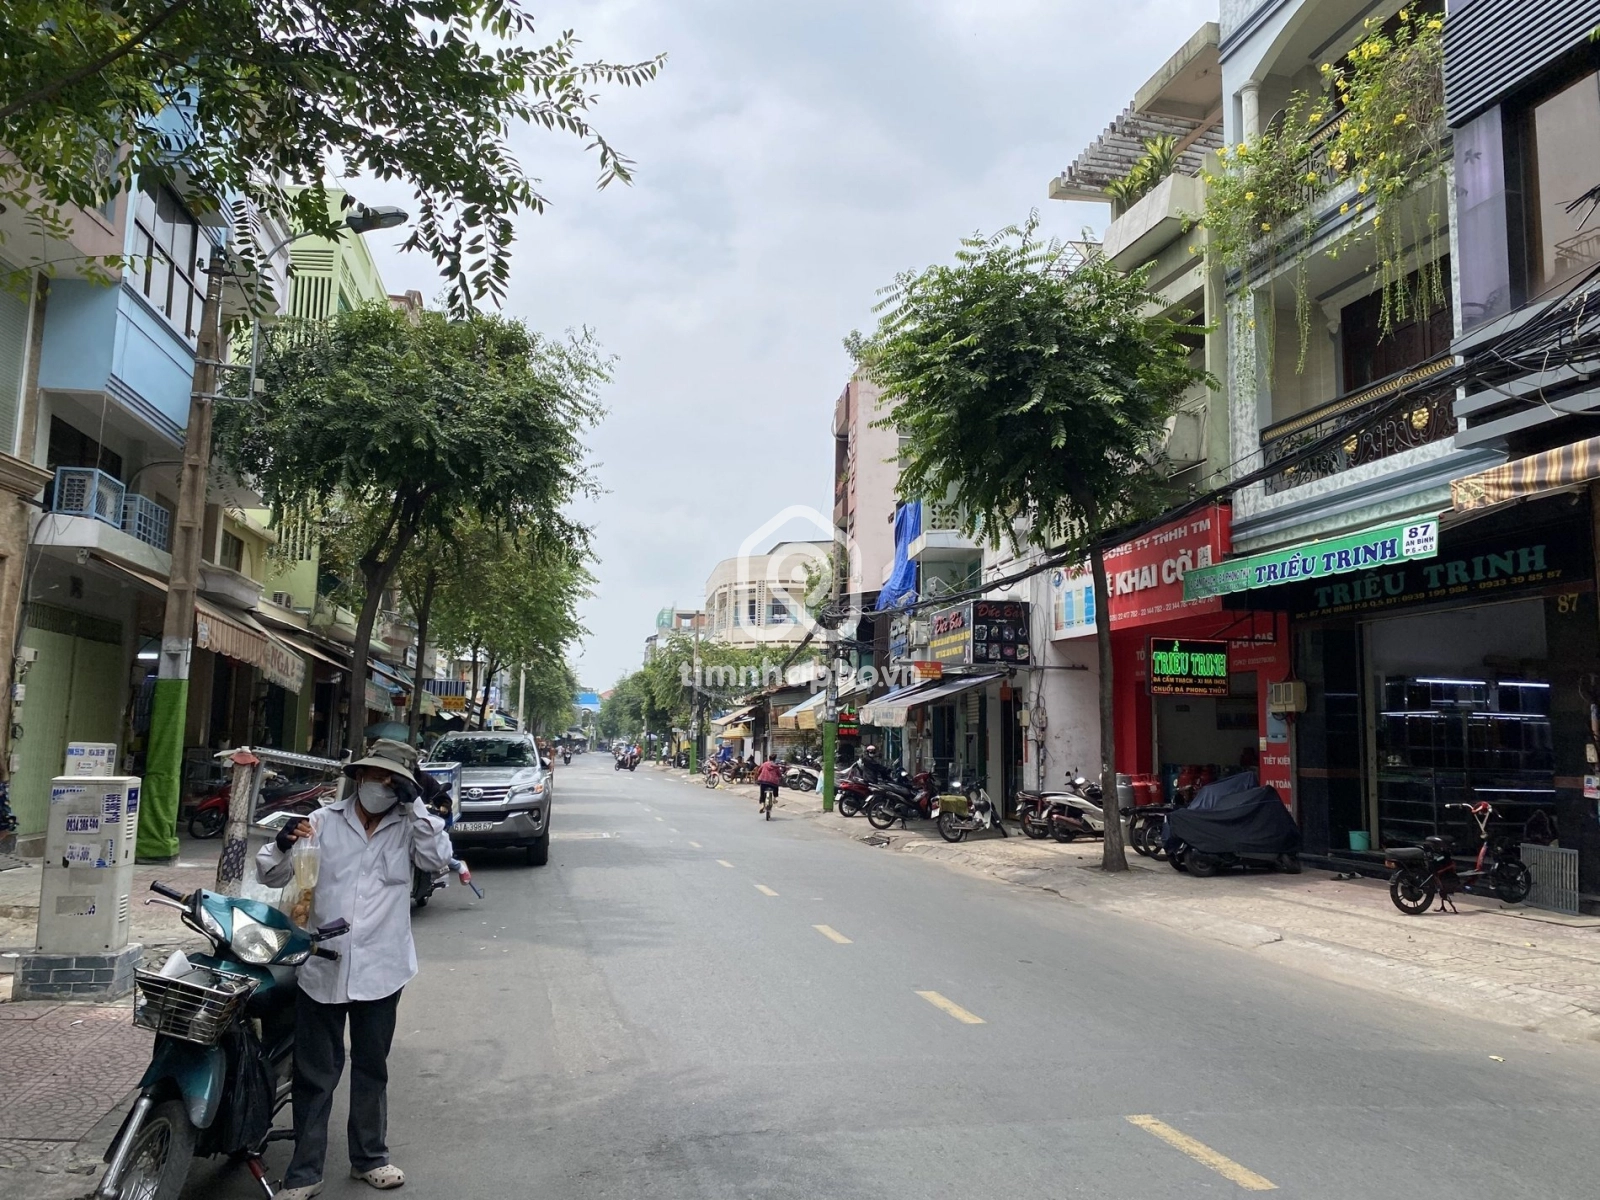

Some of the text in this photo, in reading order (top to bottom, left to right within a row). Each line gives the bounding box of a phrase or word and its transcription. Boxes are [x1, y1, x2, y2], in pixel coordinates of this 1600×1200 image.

[1135, 537, 1150, 550] TY
[1152, 525, 1188, 545] TNHH
[1191, 518, 1211, 534] TM
[1408, 524, 1430, 538] 87
[1417, 536, 1434, 545] BÌNH
[1255, 538, 1398, 583] TRIỀU TRINH
[1314, 544, 1548, 608] TRIỀU TRINH
[1115, 564, 1158, 596] KHAI
[1402, 592, 1425, 602] 0939
[1428, 588, 1446, 597] 199
[1479, 578, 1507, 589] 0933
[1510, 576, 1525, 584] 39
[1546, 569, 1562, 578] 87
[1557, 593, 1579, 613] 87
[1190, 653, 1226, 676] TRINH
